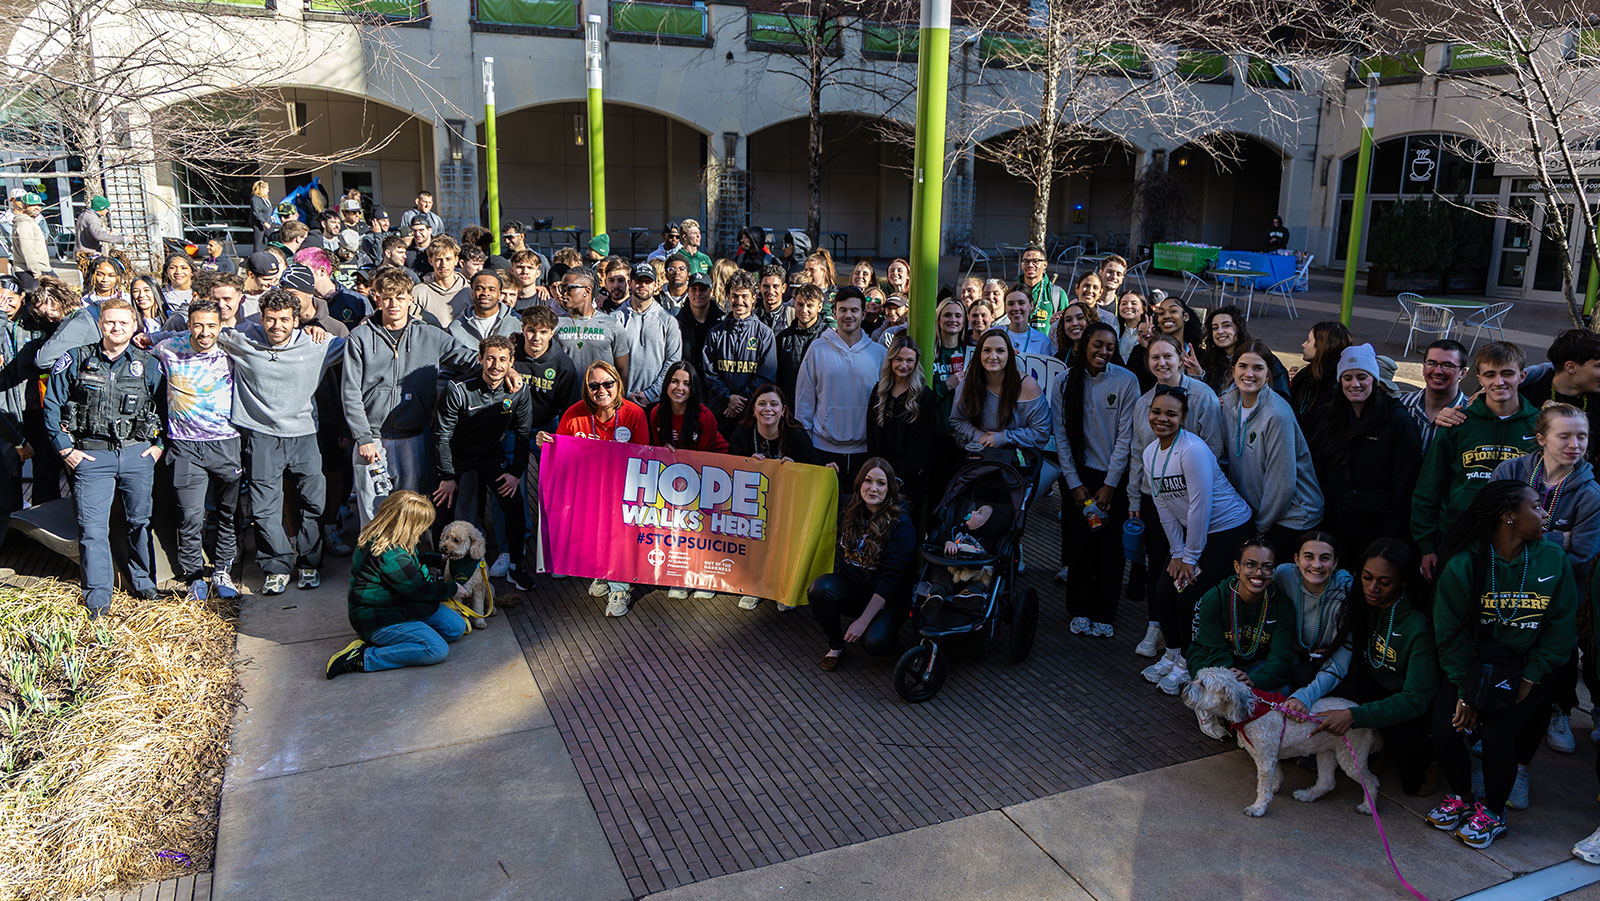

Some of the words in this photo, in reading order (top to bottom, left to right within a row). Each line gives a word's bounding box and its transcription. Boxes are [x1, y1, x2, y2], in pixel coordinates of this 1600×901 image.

[558, 326, 581, 335] POINT
[583, 326, 605, 335] PARK
[622, 456, 768, 518] HOPE
[621, 504, 704, 533] WALKS
[711, 512, 767, 542] HERE
[636, 532, 747, 556] #STOPSUICIDE
